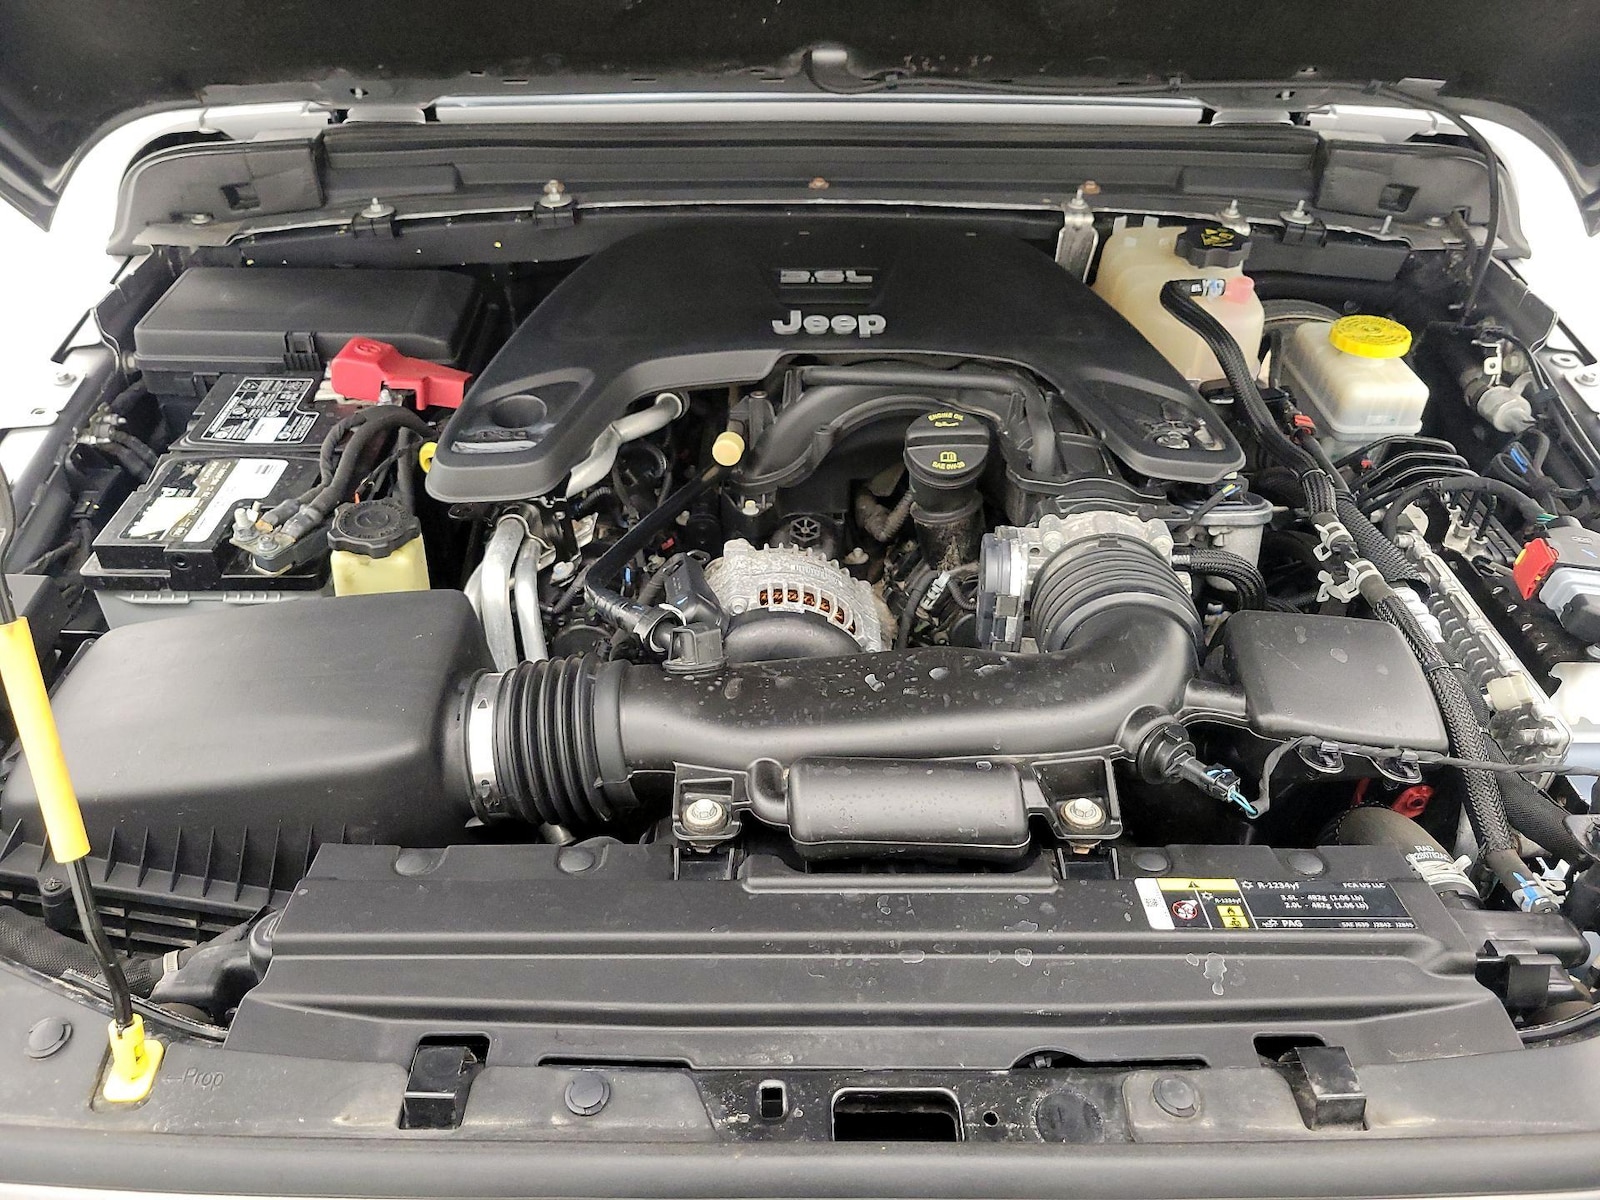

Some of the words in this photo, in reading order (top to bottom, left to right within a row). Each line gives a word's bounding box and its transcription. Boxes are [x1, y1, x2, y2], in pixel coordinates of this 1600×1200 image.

[772, 310, 887, 338] Jeep
[928, 412, 953, 421] ENGINE
[953, 413, 964, 421] OIL
[932, 461, 945, 470] SAE
[1257, 882, 1300, 890] R-1234yf
[1281, 919, 1303, 927] PAG
[183, 1066, 224, 1091] Prop
